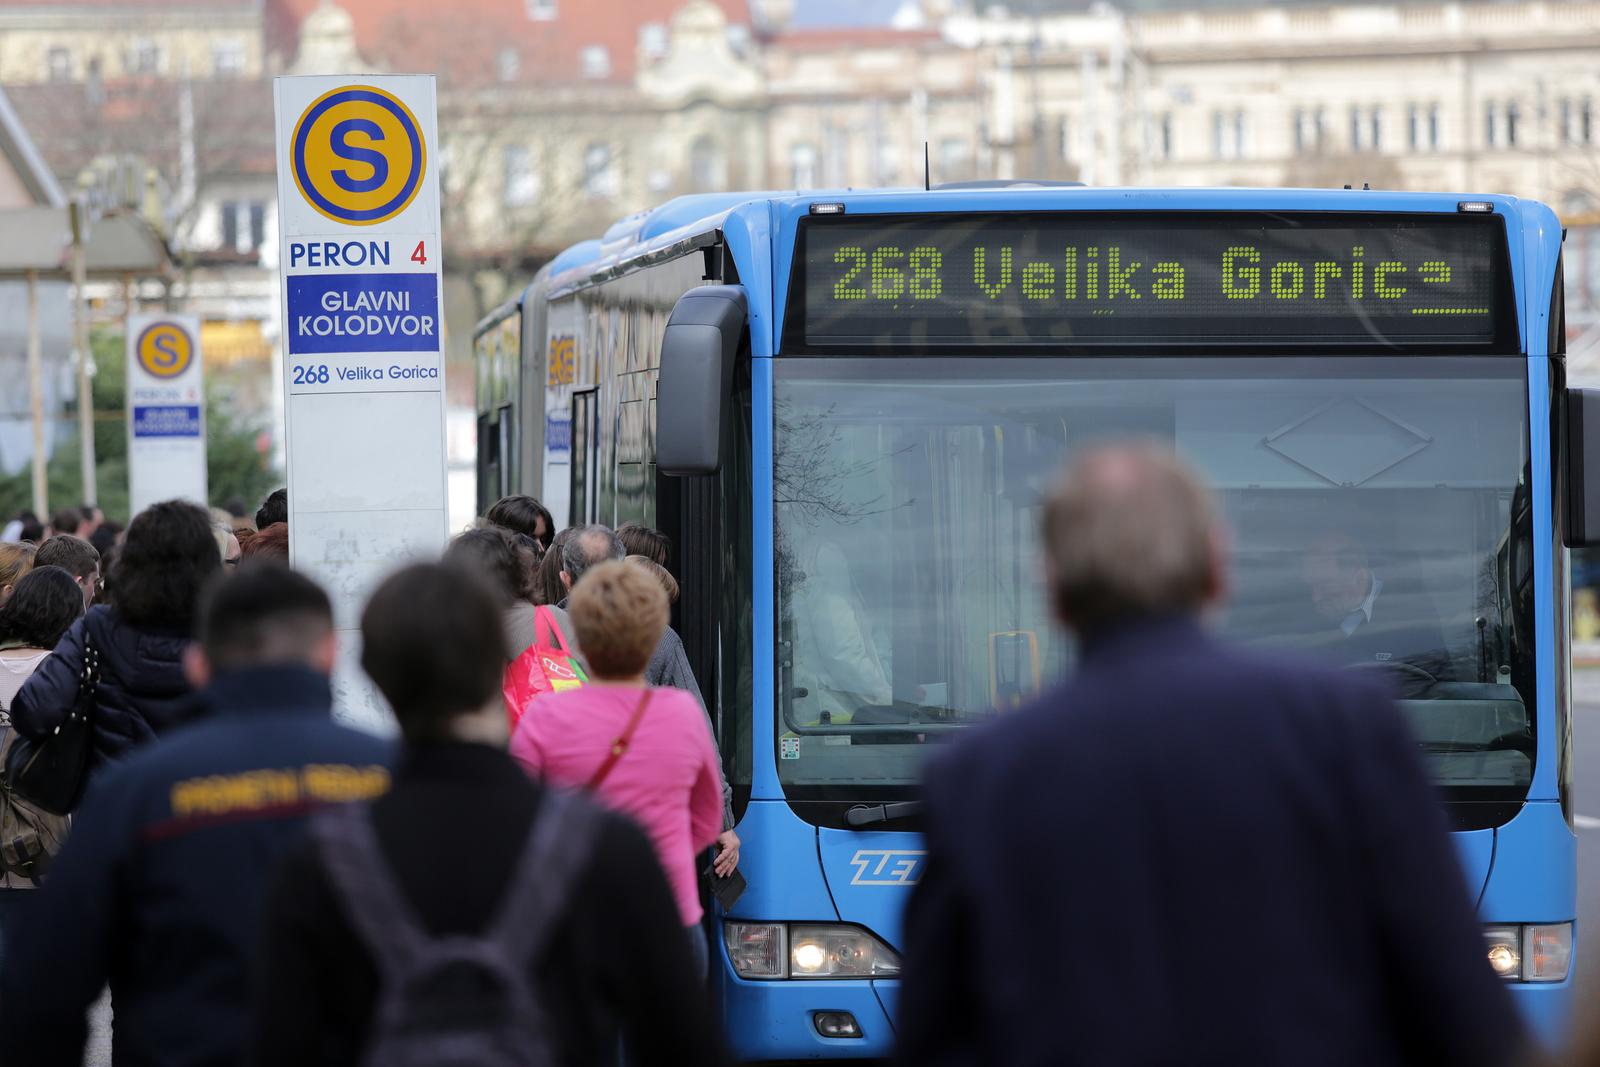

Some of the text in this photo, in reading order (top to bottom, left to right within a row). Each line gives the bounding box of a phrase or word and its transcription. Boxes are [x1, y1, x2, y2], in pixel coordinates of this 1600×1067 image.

[290, 240, 427, 267] PERON 4
[833, 246, 941, 298] 268
[974, 246, 1185, 298] Velika
[321, 291, 410, 312] GLAVNI
[298, 315, 434, 336] KOLODVOR
[293, 364, 438, 385] 268 Velika Gorica
